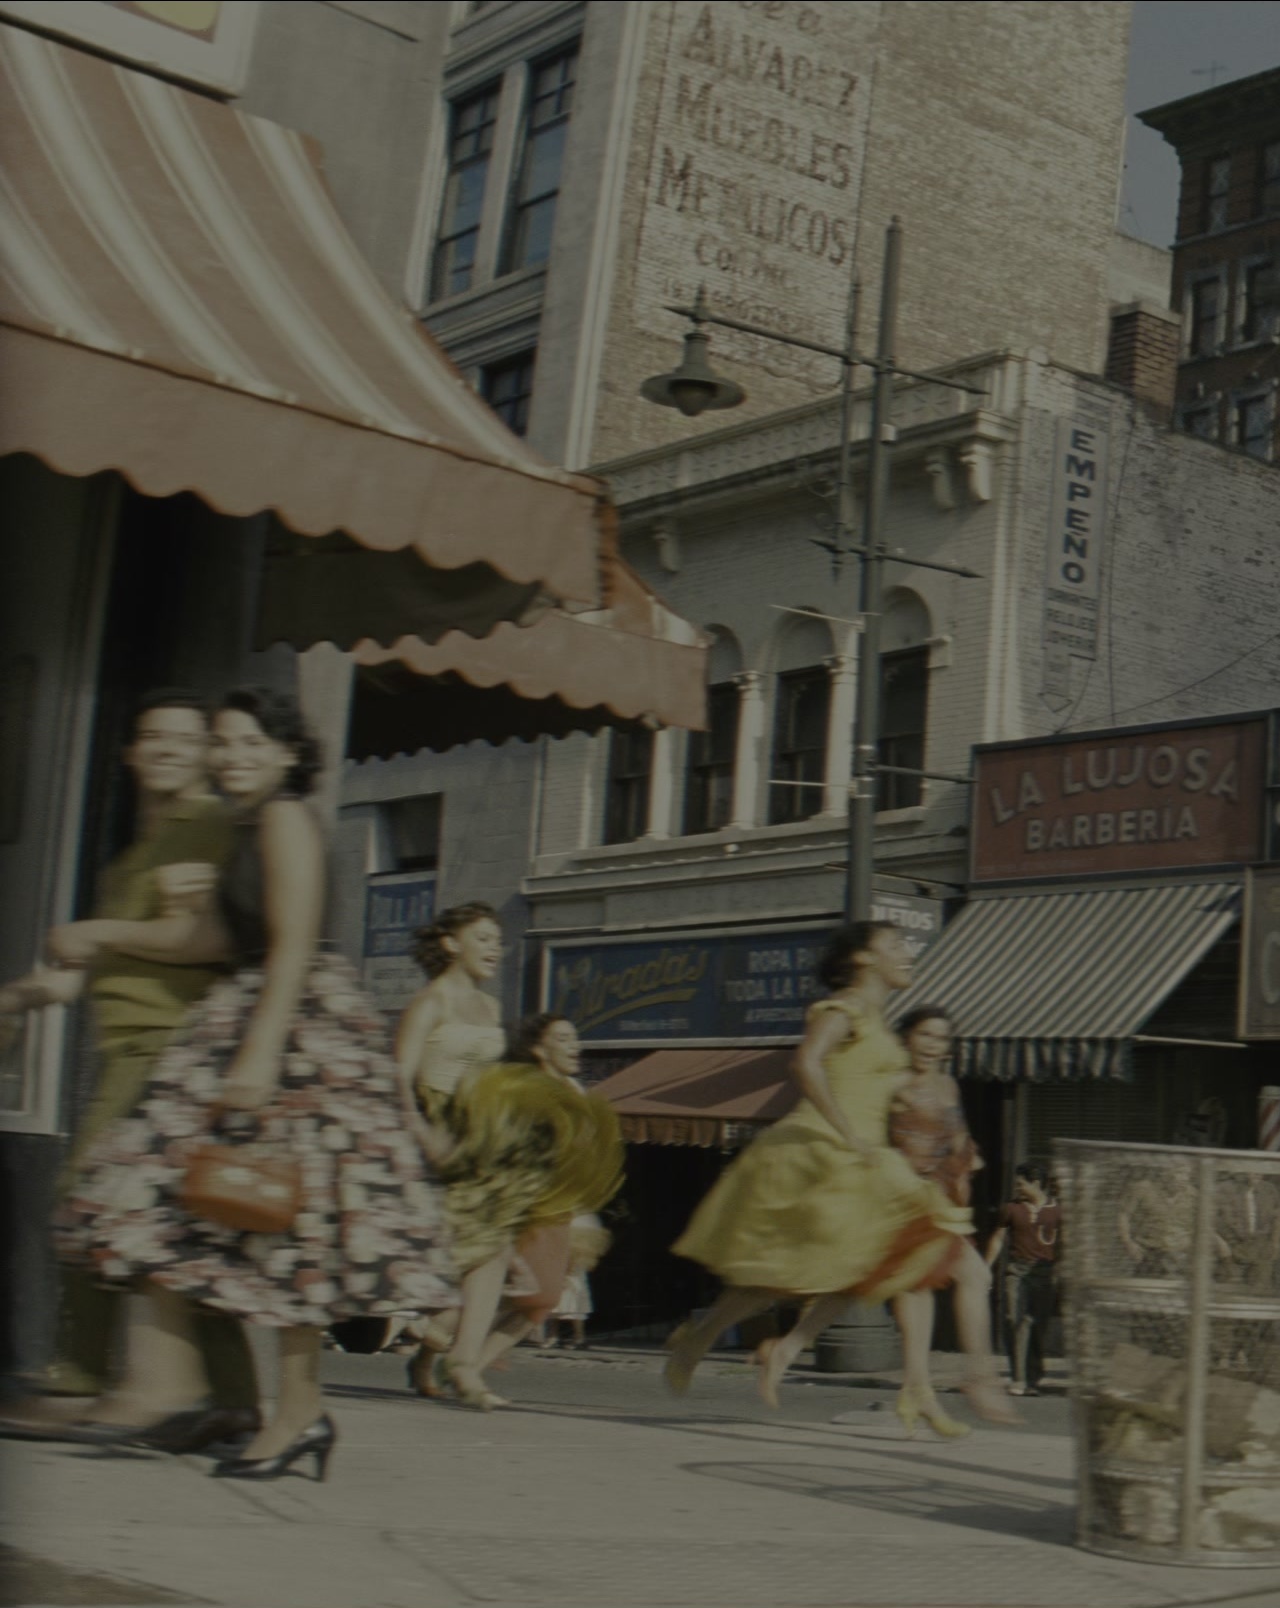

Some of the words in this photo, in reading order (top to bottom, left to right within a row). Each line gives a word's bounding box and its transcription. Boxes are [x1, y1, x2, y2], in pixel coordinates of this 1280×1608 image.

[676, 74, 851, 189] MUEBLES
[1060, 428, 1097, 585] EMPEÑO
[990, 770, 1045, 826] LA
[1062, 744, 1240, 802] LUJOSA
